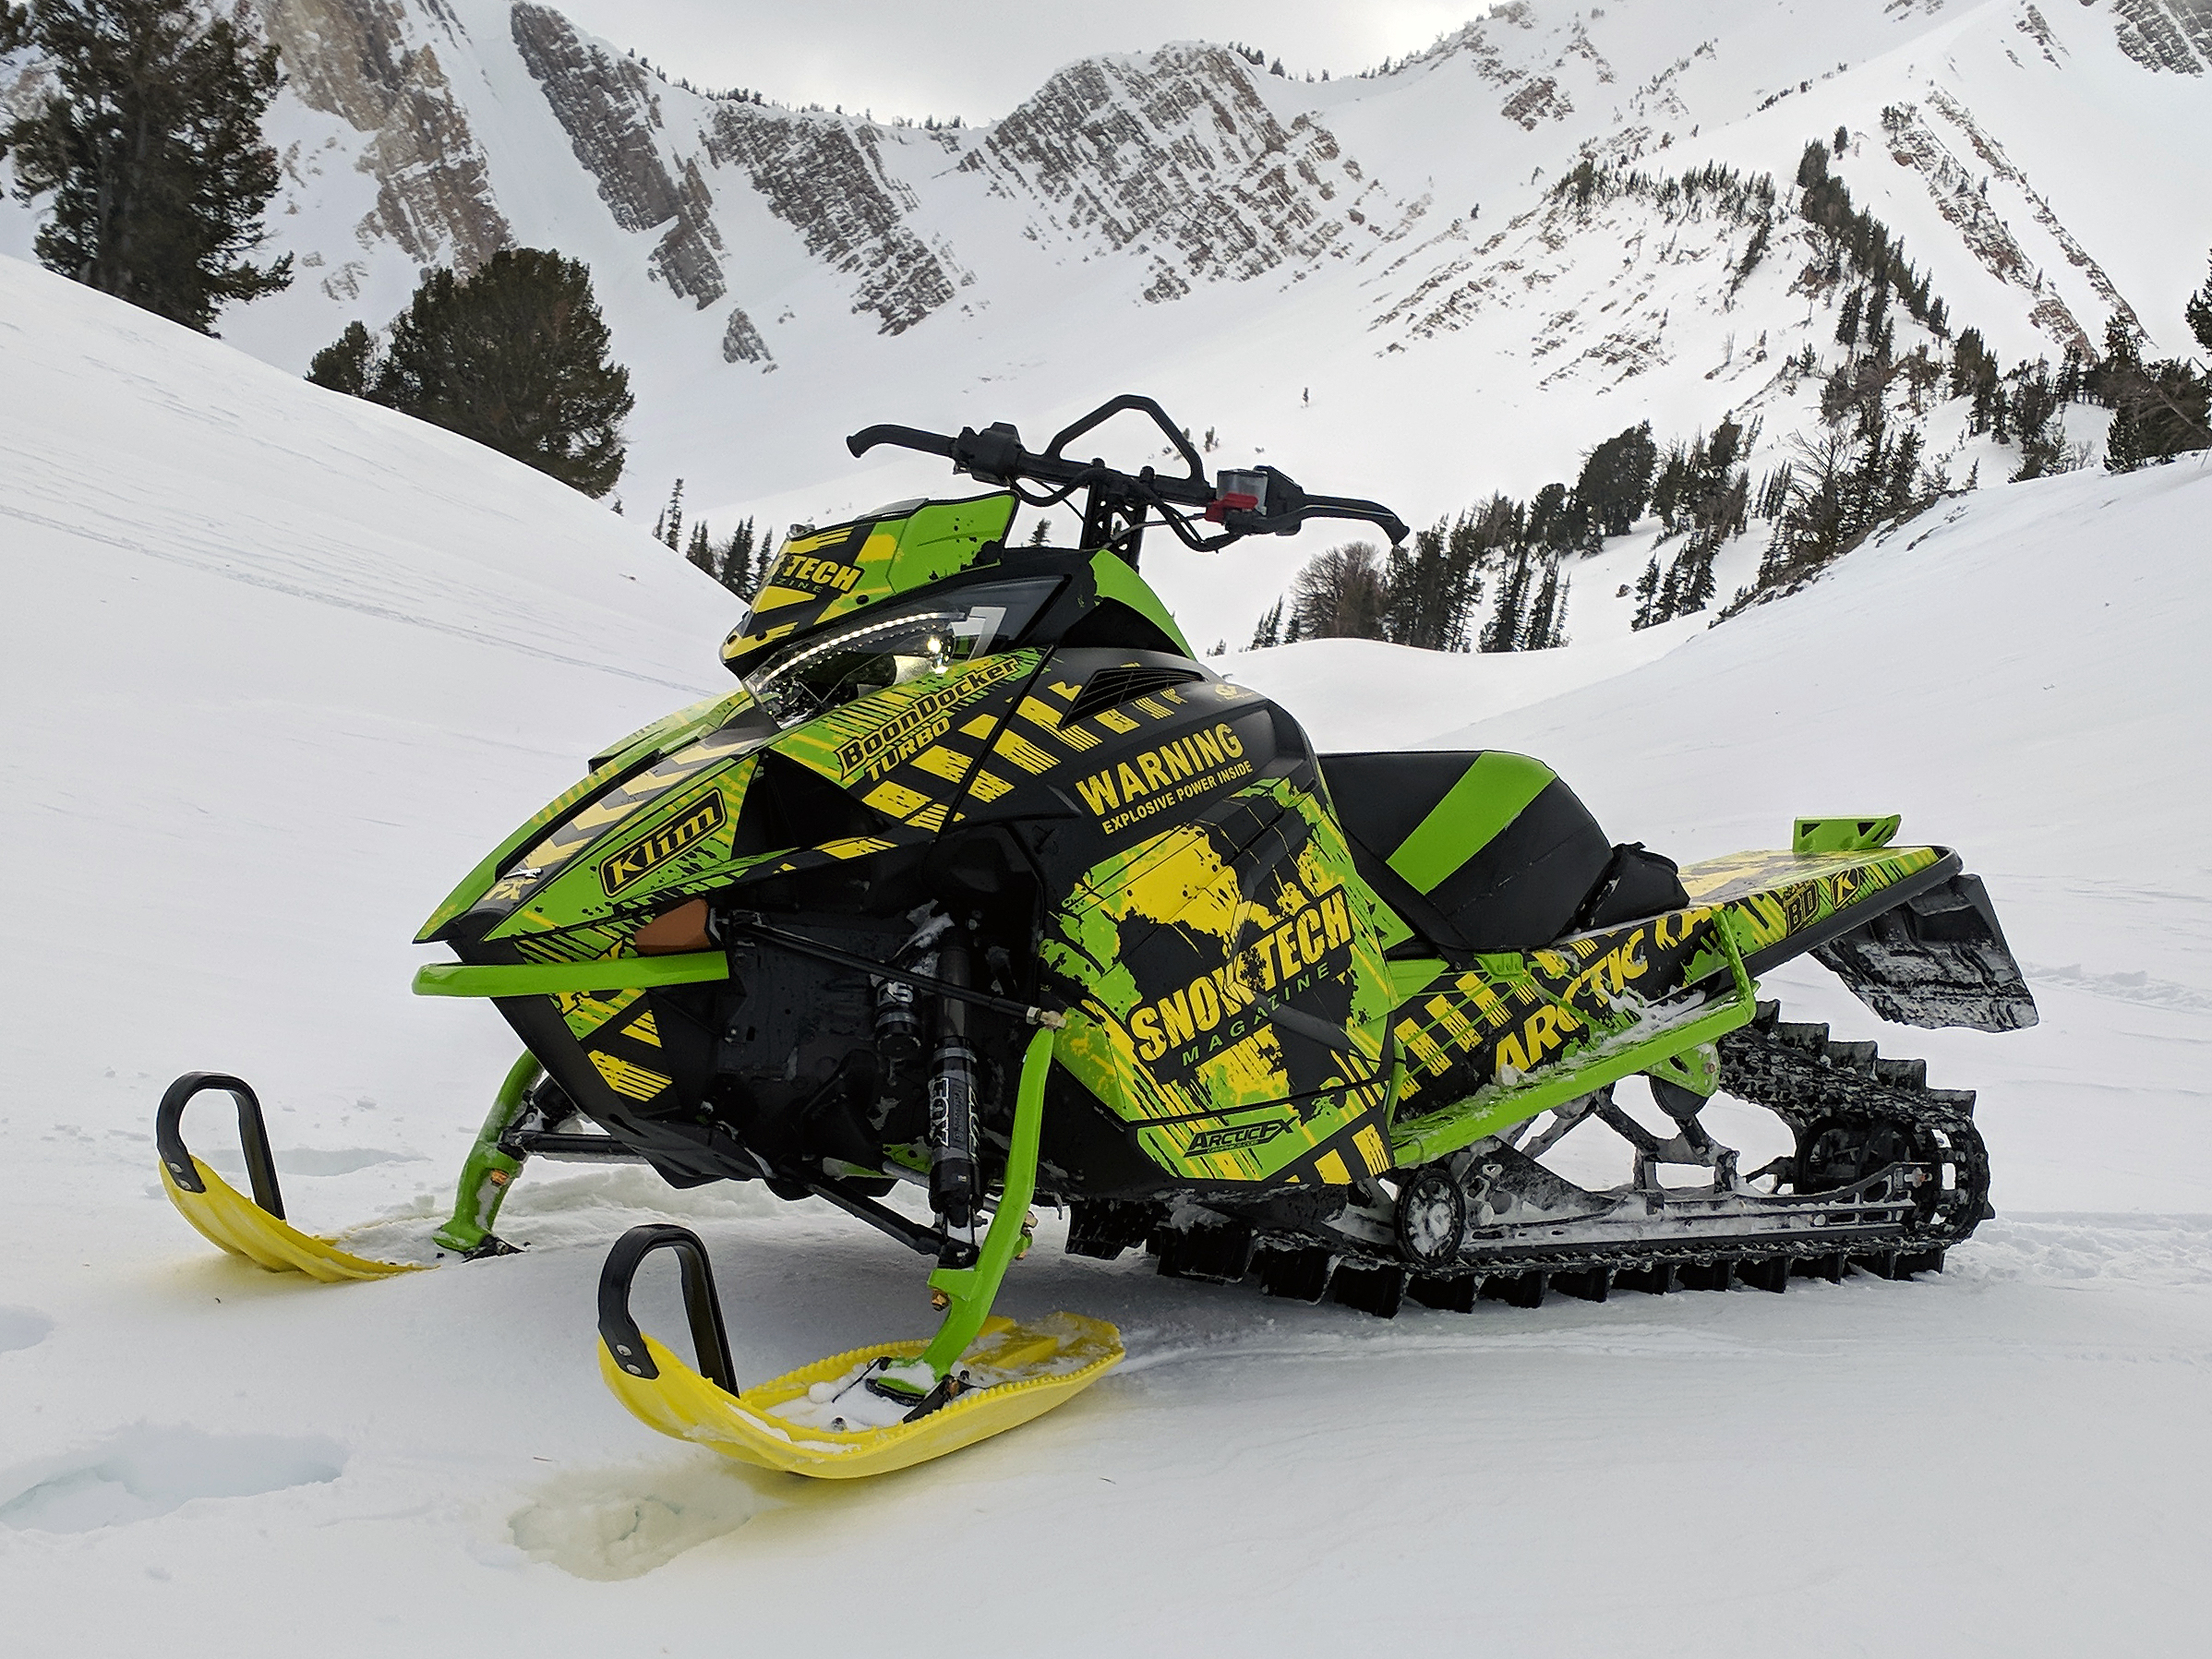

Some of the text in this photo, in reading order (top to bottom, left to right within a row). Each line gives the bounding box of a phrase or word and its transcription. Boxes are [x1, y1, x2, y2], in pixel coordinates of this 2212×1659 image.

[782, 555, 861, 592] TECH
[866, 716, 952, 782] TURBO
[1076, 722, 1244, 817] WARNING
[1102, 759, 1254, 835] EXPLOSIVE POWER INSIDE
[1130, 891, 1352, 1062] SNOW TECH
[1182, 962, 1330, 1067] MAGAZINE
[1495, 928, 1649, 1075] ARCTIC
[927, 1076, 949, 1147] FOX
